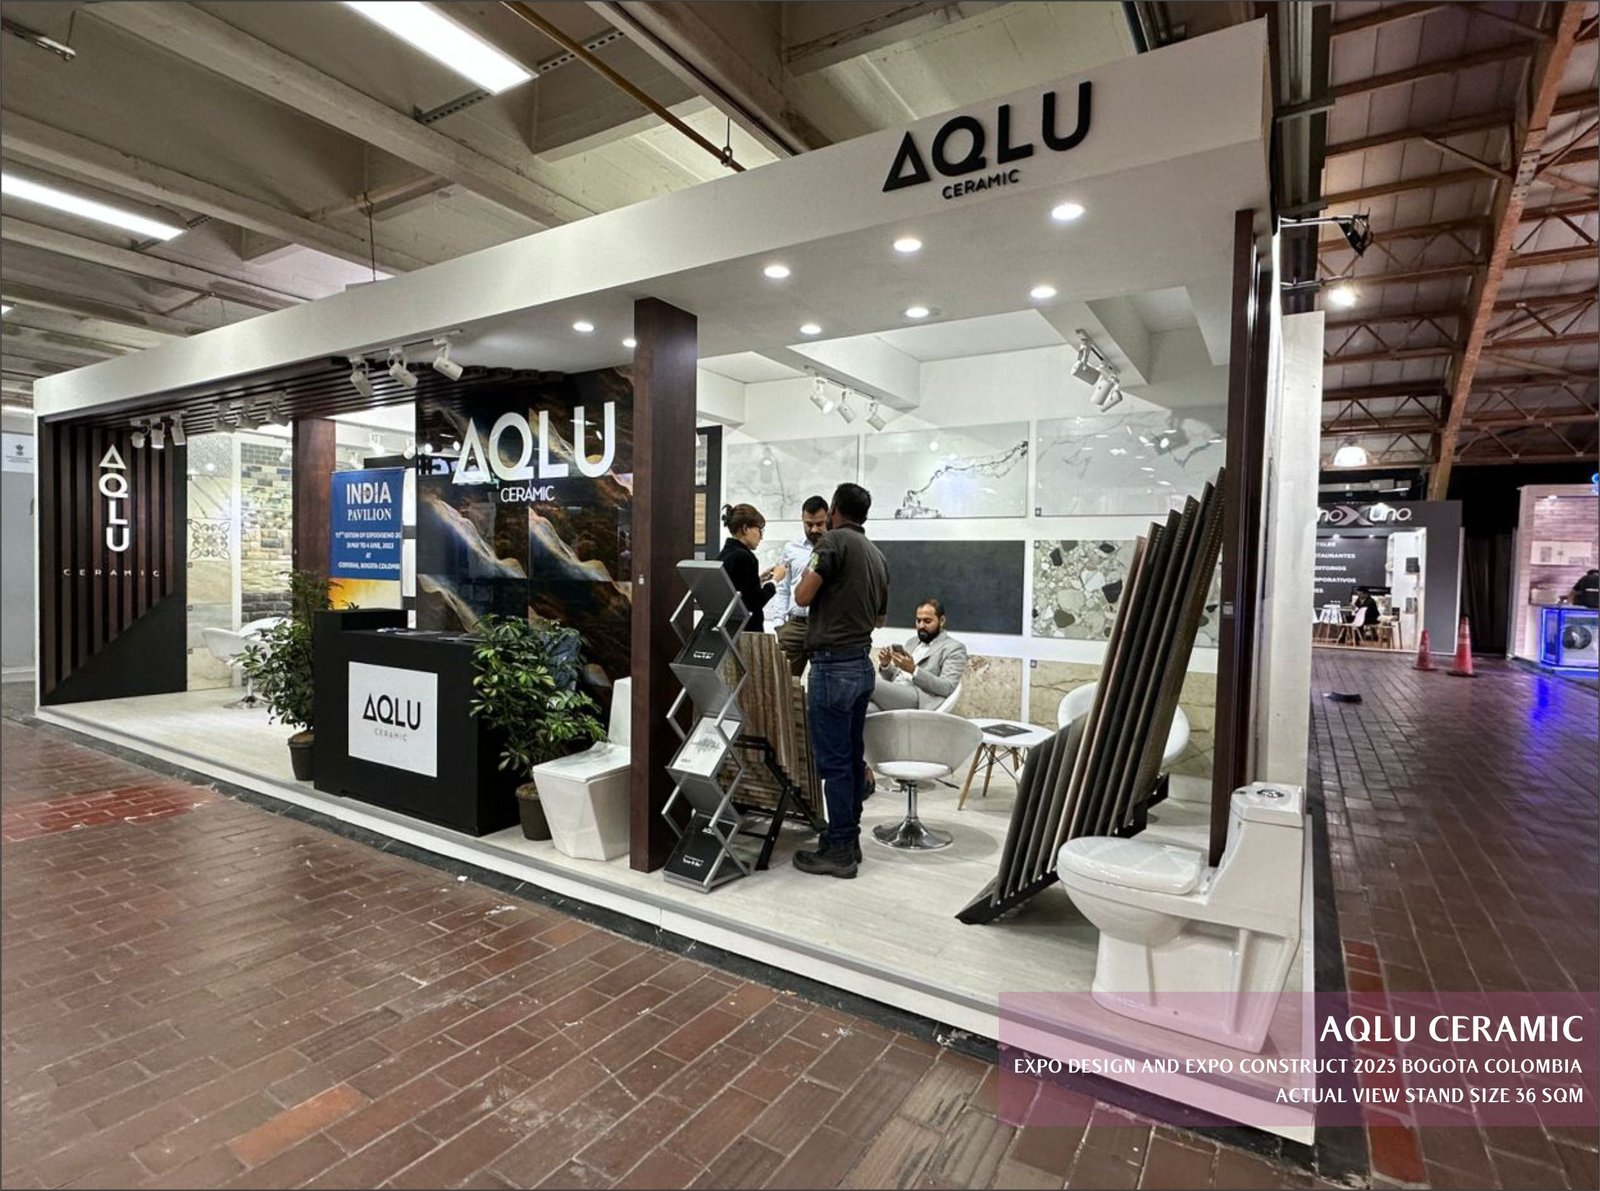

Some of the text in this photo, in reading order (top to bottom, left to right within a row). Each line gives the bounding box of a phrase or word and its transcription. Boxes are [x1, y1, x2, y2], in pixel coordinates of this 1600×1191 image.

[882, 81, 1092, 192] AQLU
[942, 169, 1020, 200] CERAMIC
[452, 401, 615, 484] AQLU
[98, 444, 130, 552] AQLU
[346, 482, 392, 505] INDIA
[500, 485, 556, 503] CERAMIC
[347, 507, 392, 521] PAVILION
[63, 569, 160, 578] CERAMIC
[362, 692, 421, 731] AQLU
[374, 728, 408, 742] CERAMIC
